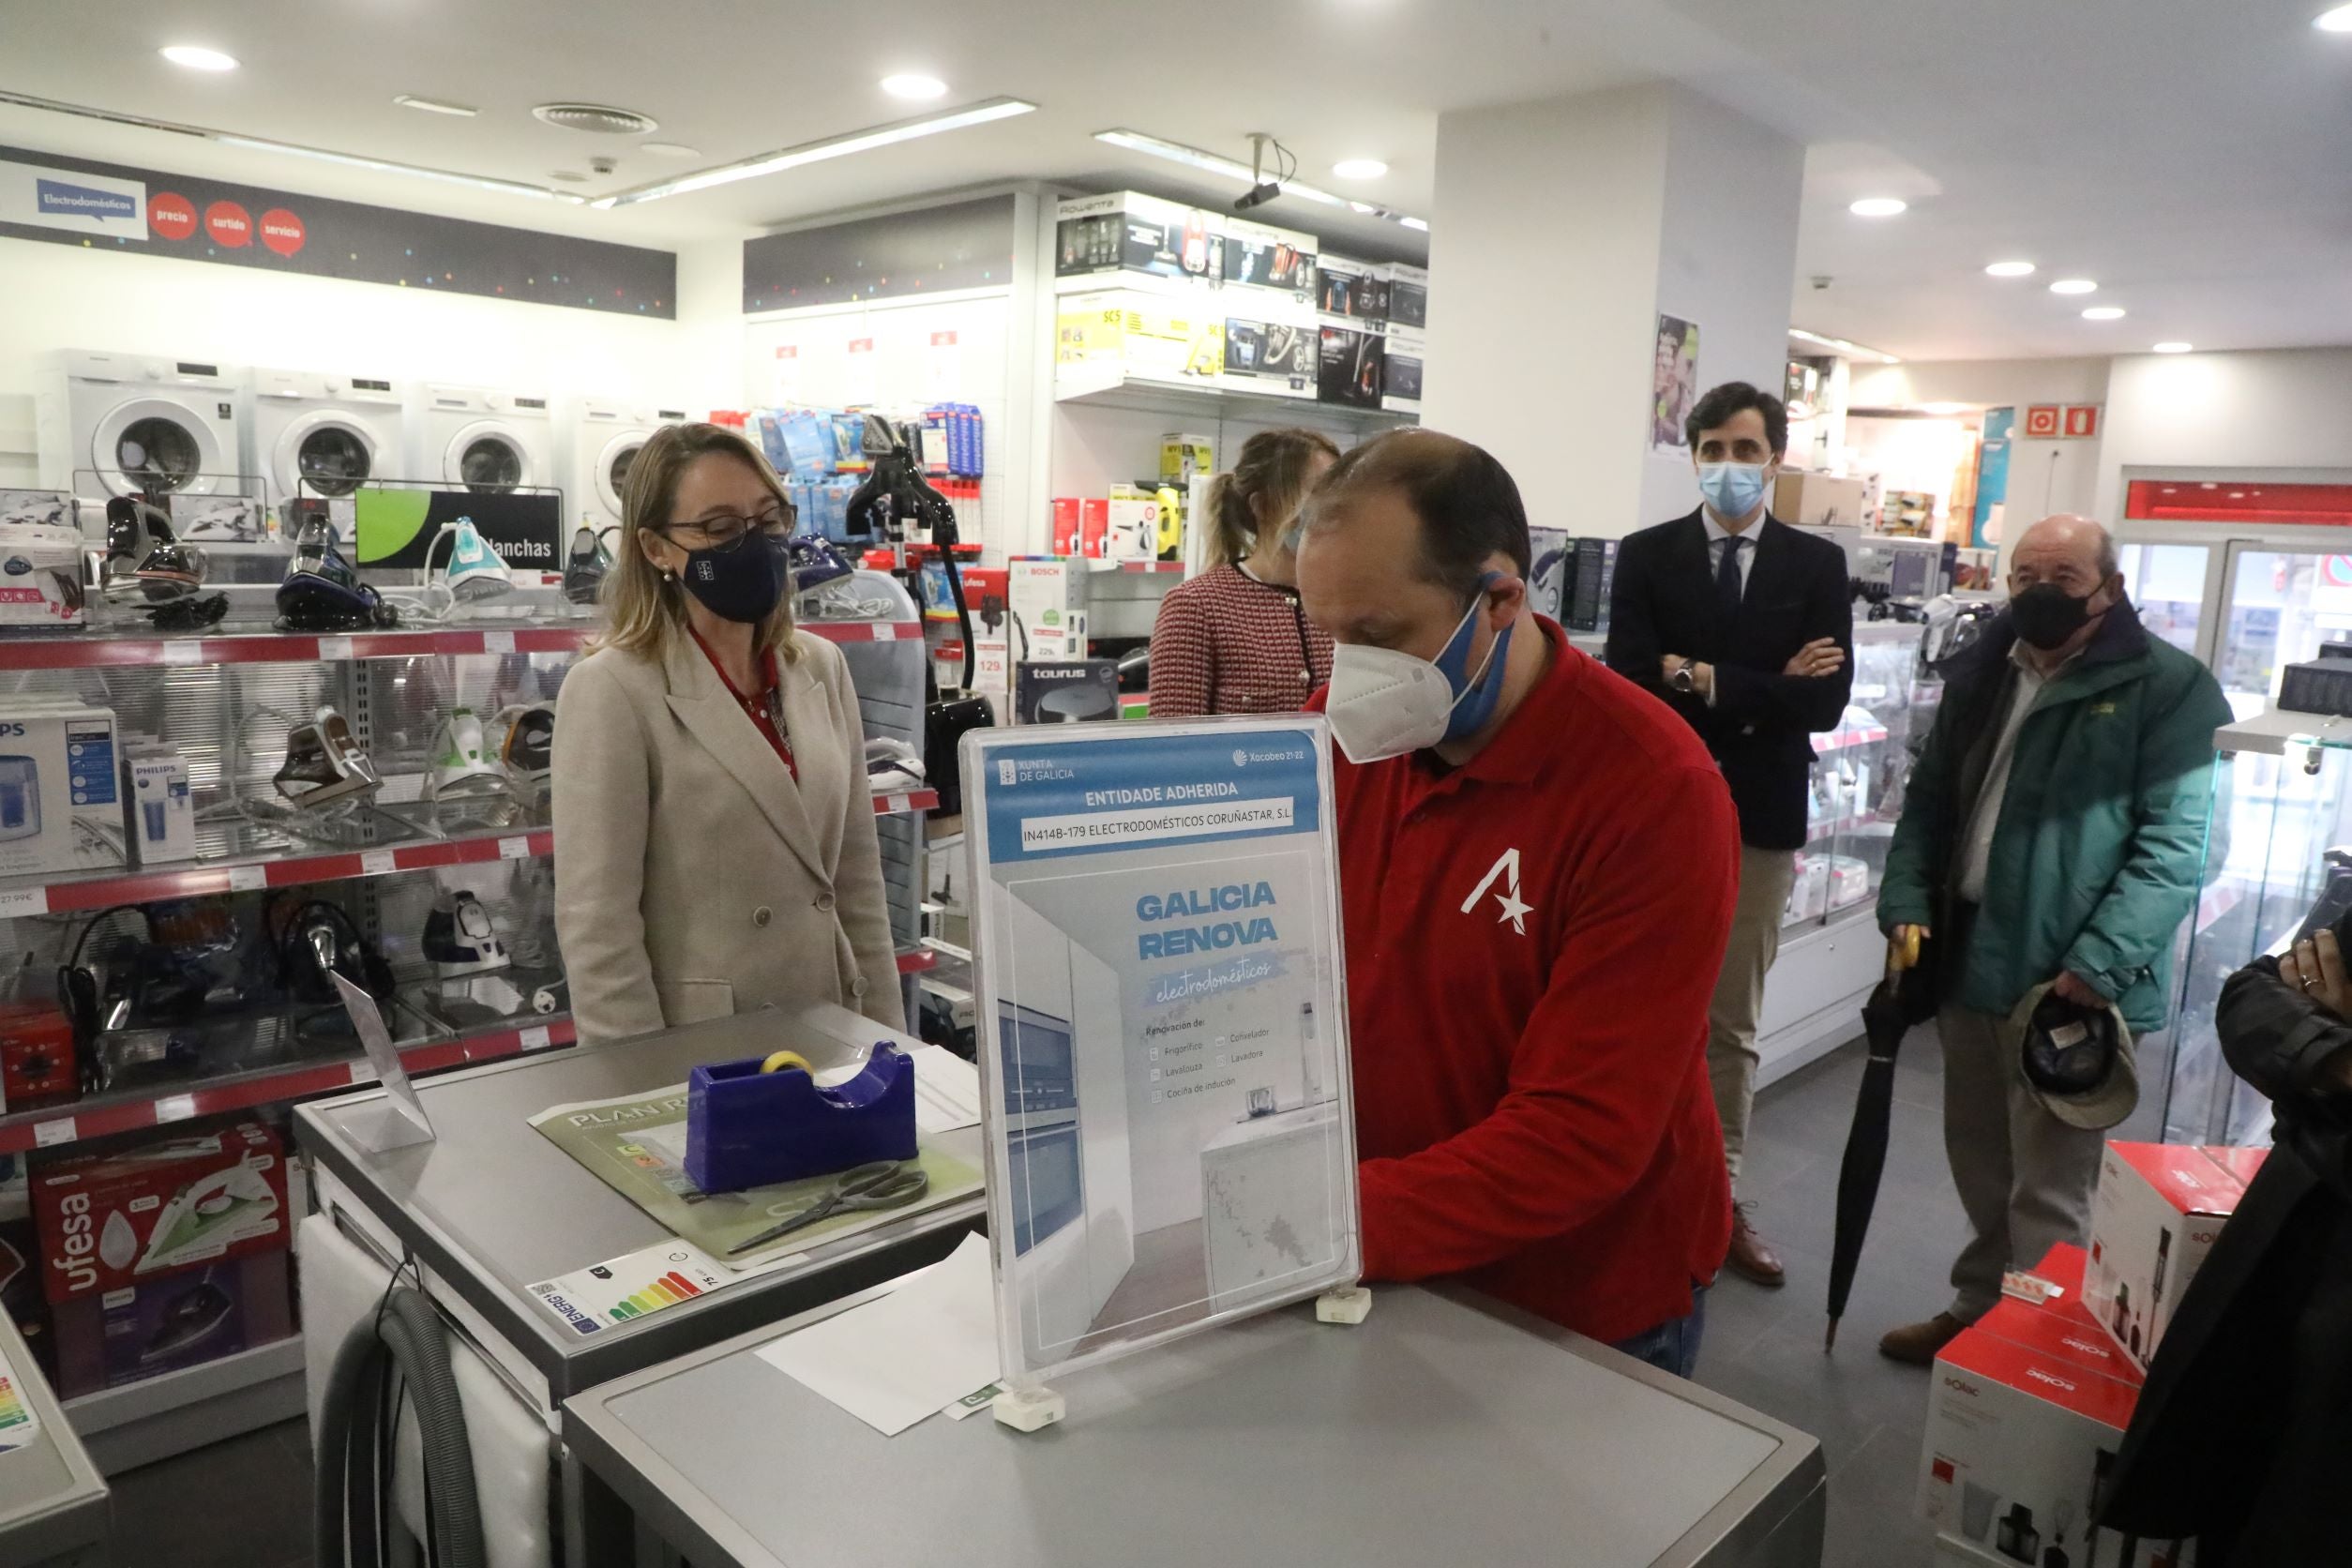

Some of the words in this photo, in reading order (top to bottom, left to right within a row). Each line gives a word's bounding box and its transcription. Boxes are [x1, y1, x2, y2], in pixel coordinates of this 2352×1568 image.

[44, 193, 131, 211] Electrodomésticos
[157, 209, 188, 223] precio
[212, 217, 245, 232] surtido
[264, 224, 300, 239] servicio
[489, 538, 551, 557] lanchas
[1031, 567, 1059, 577] BOSCH
[964, 577, 986, 587] ufesa
[1033, 668, 1086, 679] taurus
[1019, 759, 1054, 770] XUNTA
[1249, 751, 1285, 763] Xacobeo
[136, 764, 176, 776] PHILIPS
[1020, 771, 1033, 781] DE
[1035, 769, 1075, 781] GALICIA
[1085, 786, 1163, 807] ENTIDADE
[1166, 781, 1239, 801] ADHERIDA
[1023, 821, 1086, 843] IN414B-179
[1089, 813, 1204, 837] ELECTRODOMÉSTICOS
[1206, 808, 1274, 826] CORUÑASTAR,
[1276, 807, 1293, 820] S.L.
[1136, 882, 1276, 922] GALICIA
[1138, 917, 1279, 960] RENOVA
[1156, 957, 1272, 1003] electrodomésticos
[1146, 1019, 1192, 1036] Renovación
[1165, 1042, 1203, 1057] Frigorífico
[1230, 1049, 1263, 1063] Lavadora
[1166, 1063, 1203, 1078] Lavalouza
[1194, 1083, 1203, 1093] de
[568, 1104, 661, 1127] PLAN
[53, 1192, 98, 1291] ufesa
